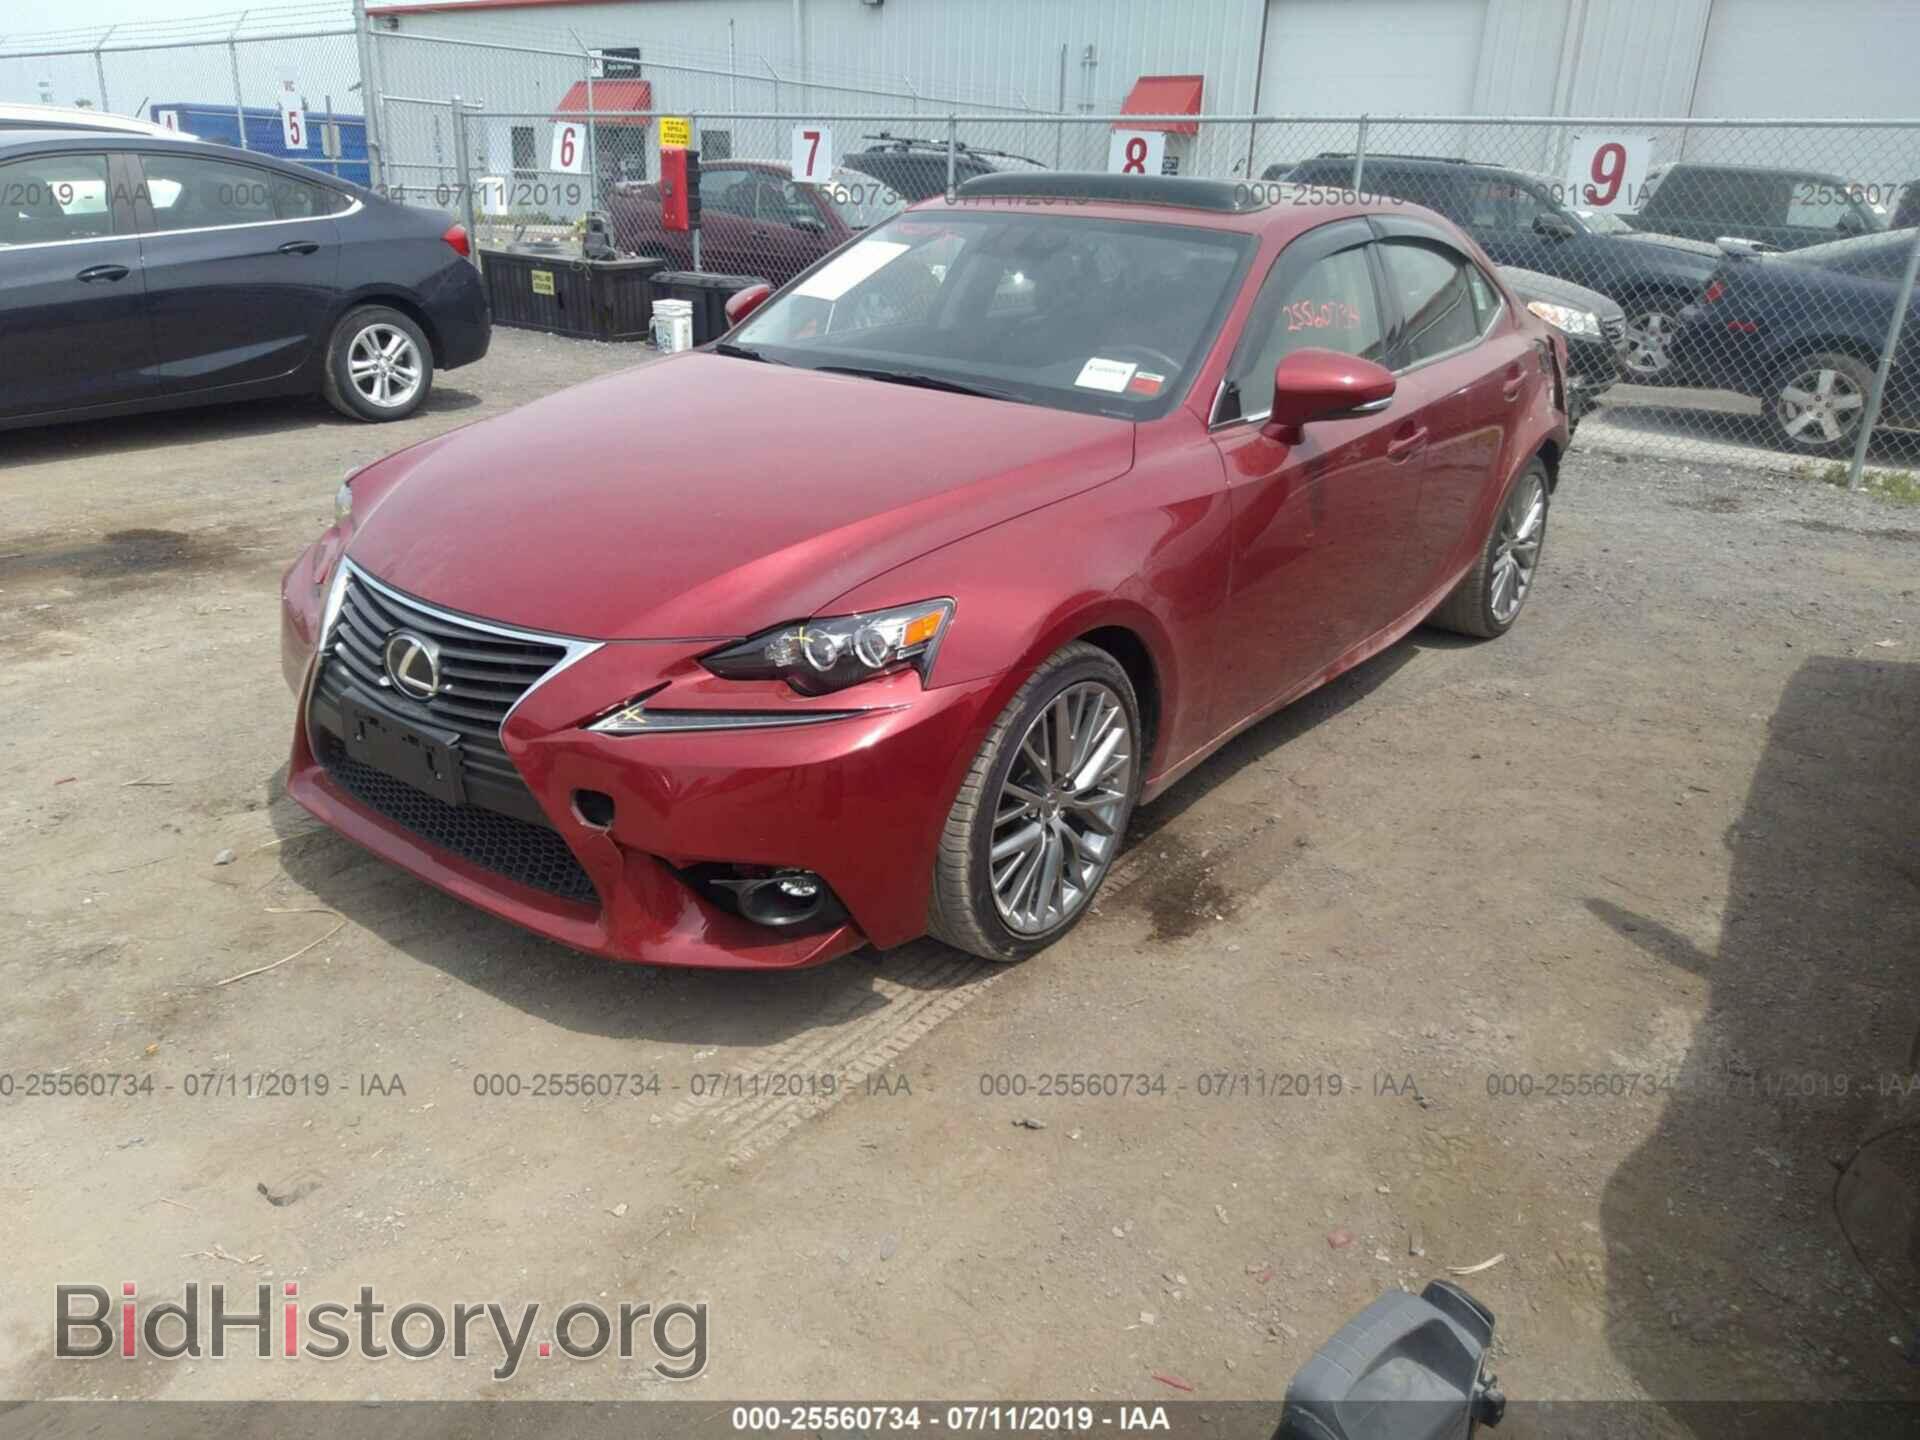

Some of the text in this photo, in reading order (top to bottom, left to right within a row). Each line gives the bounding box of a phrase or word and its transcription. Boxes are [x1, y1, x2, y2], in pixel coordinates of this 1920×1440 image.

[288, 111, 300, 145] 5
[561, 127, 576, 167] 6
[803, 131, 820, 177] 7
[1587, 142, 1627, 206] 9
